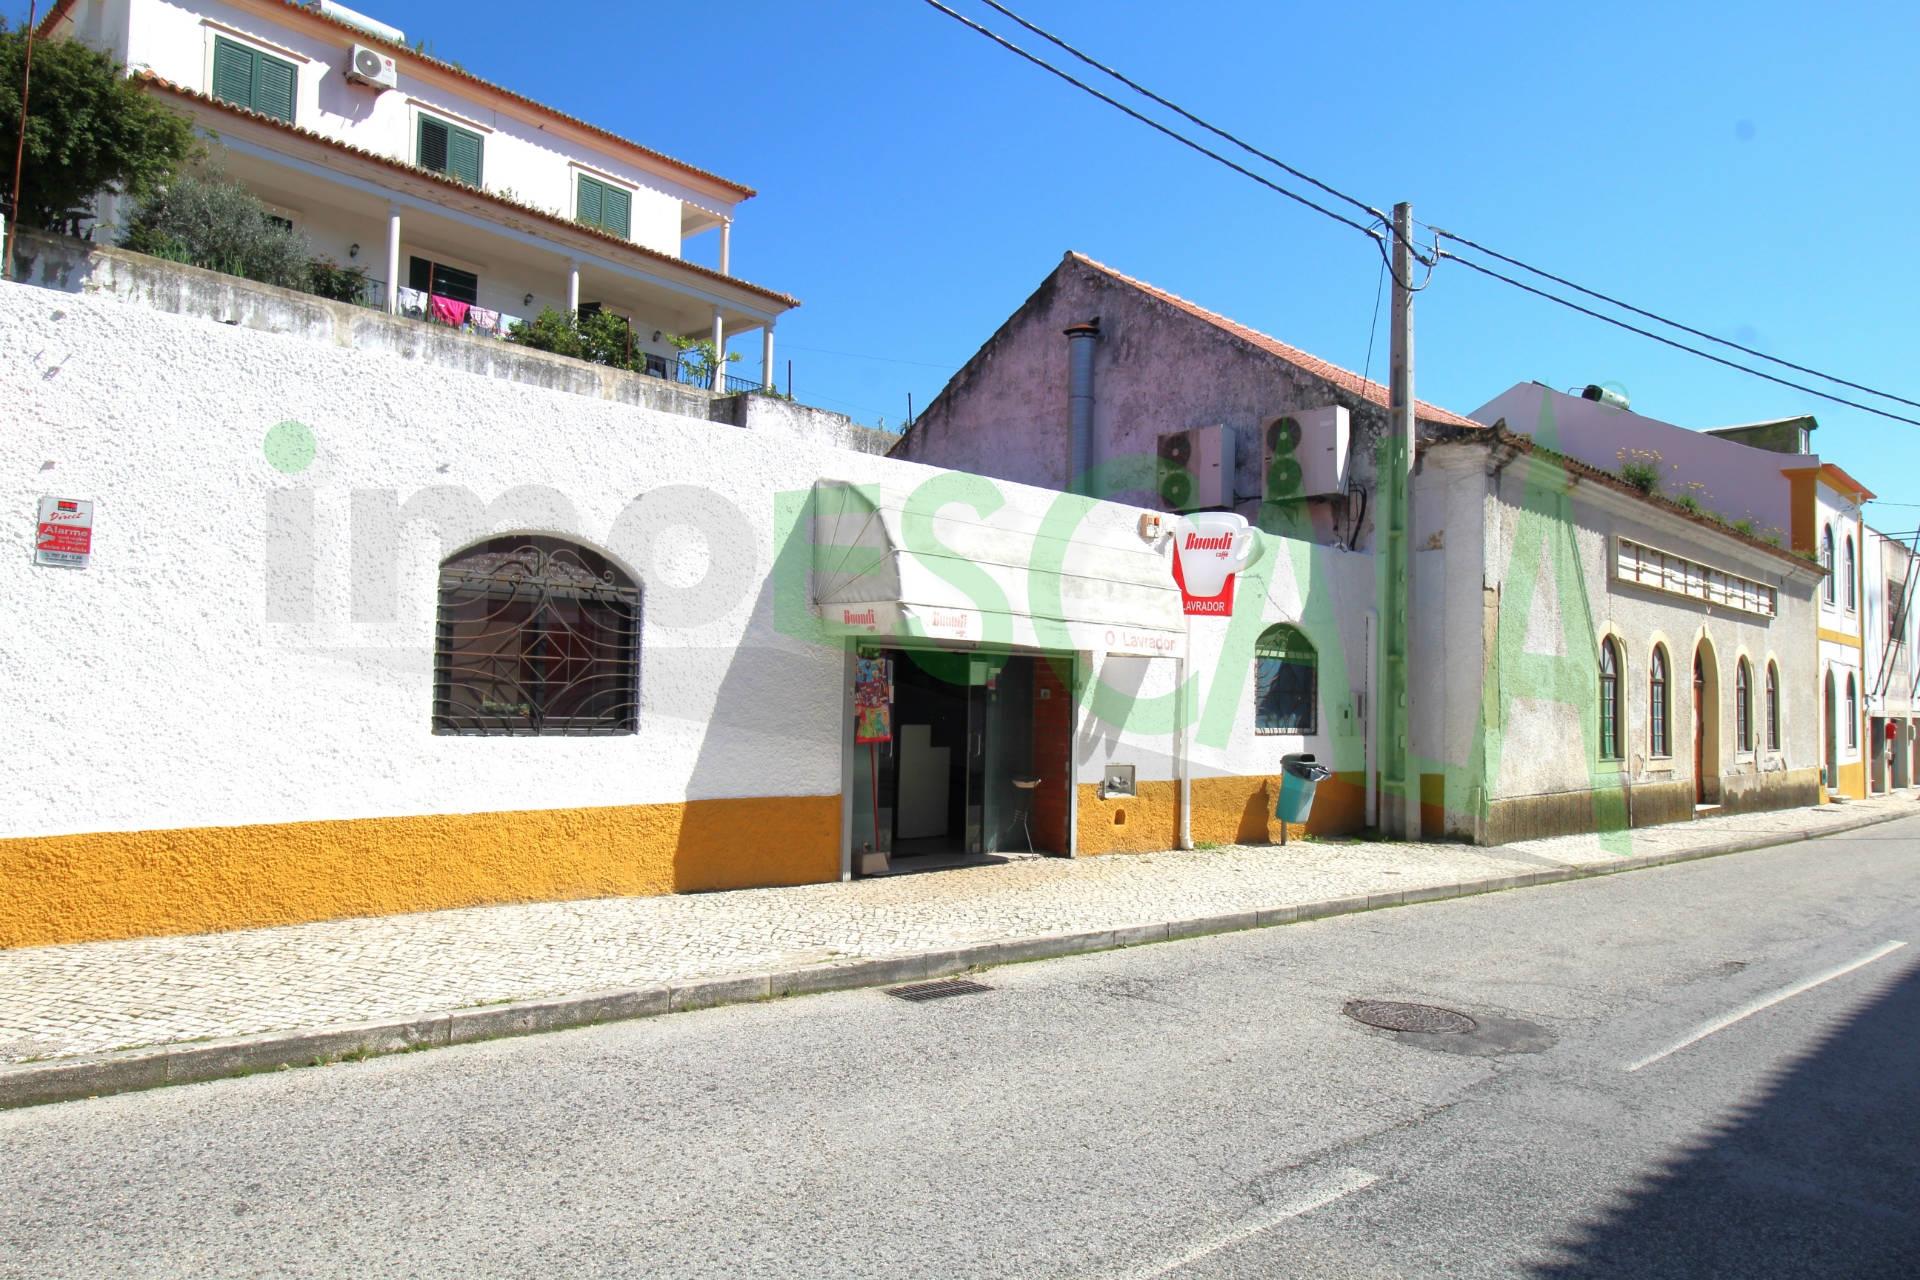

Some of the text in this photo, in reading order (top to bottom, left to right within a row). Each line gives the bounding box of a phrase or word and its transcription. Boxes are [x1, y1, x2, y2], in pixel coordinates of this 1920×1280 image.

[1185, 532, 1233, 550] Buondi
[1184, 601, 1225, 612] AVRADOR
[1122, 632, 1176, 652] Lavrador
